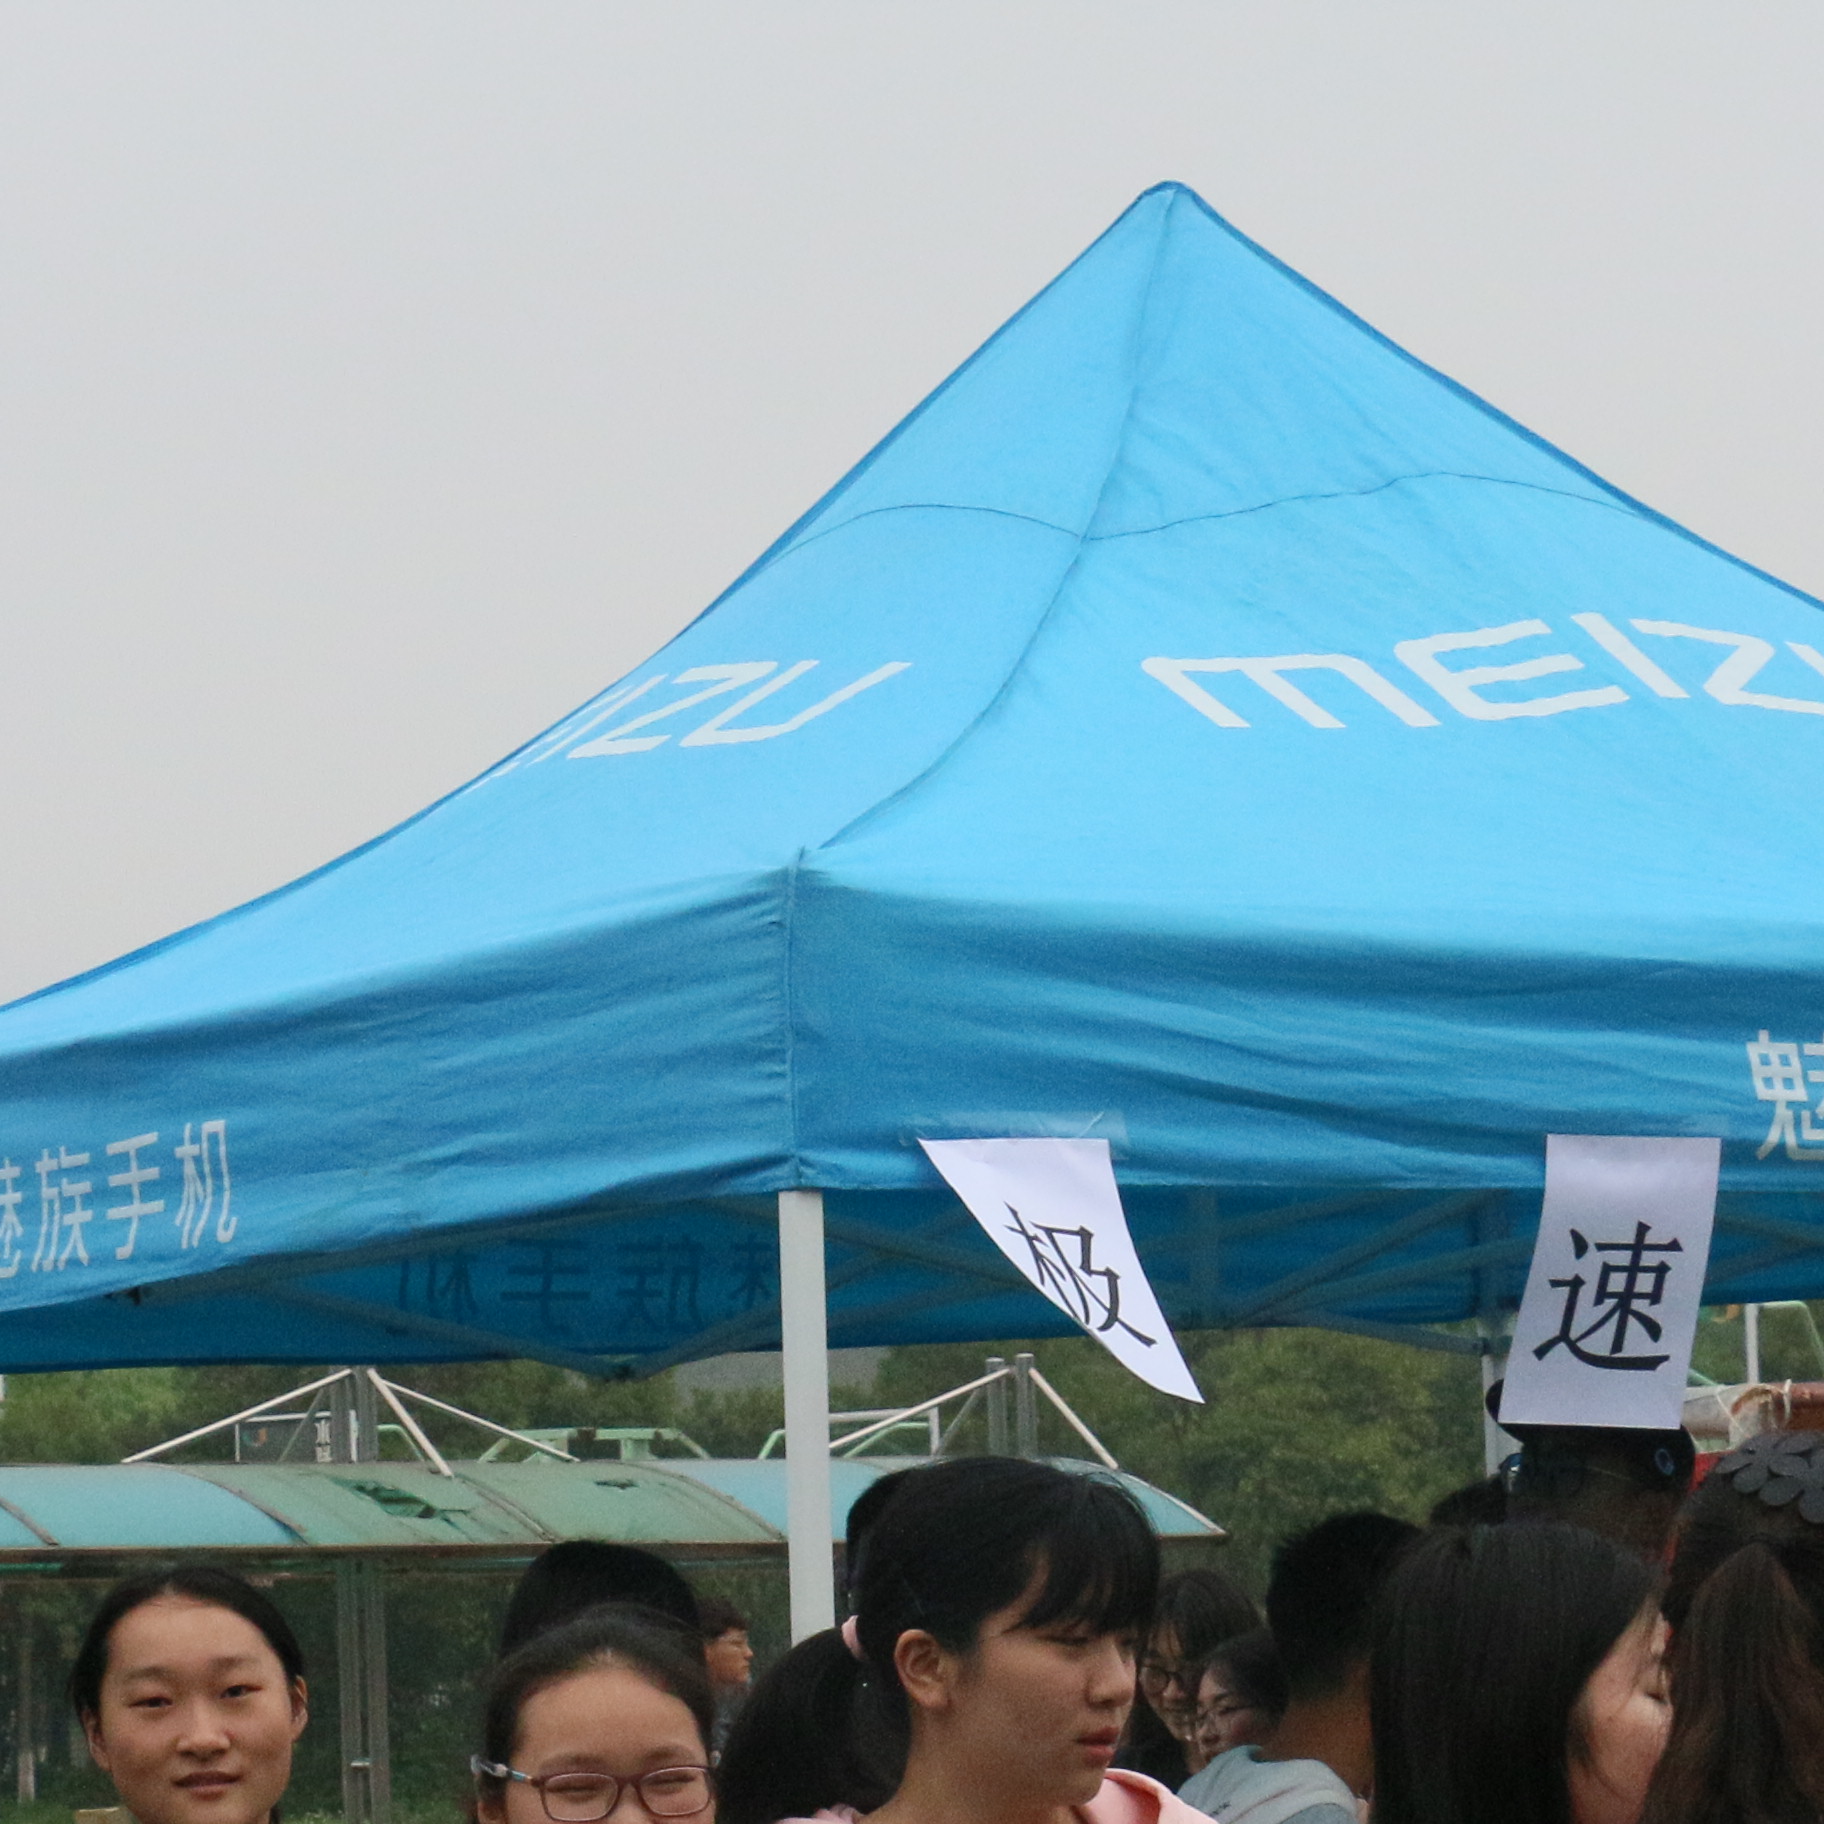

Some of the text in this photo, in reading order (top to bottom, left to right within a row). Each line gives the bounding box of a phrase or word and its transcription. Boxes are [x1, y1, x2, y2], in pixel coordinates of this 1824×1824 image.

[461, 660, 913, 797] IZU
[1003, 1200, 1157, 1348] 极
[1532, 1220, 1684, 1372] 速
